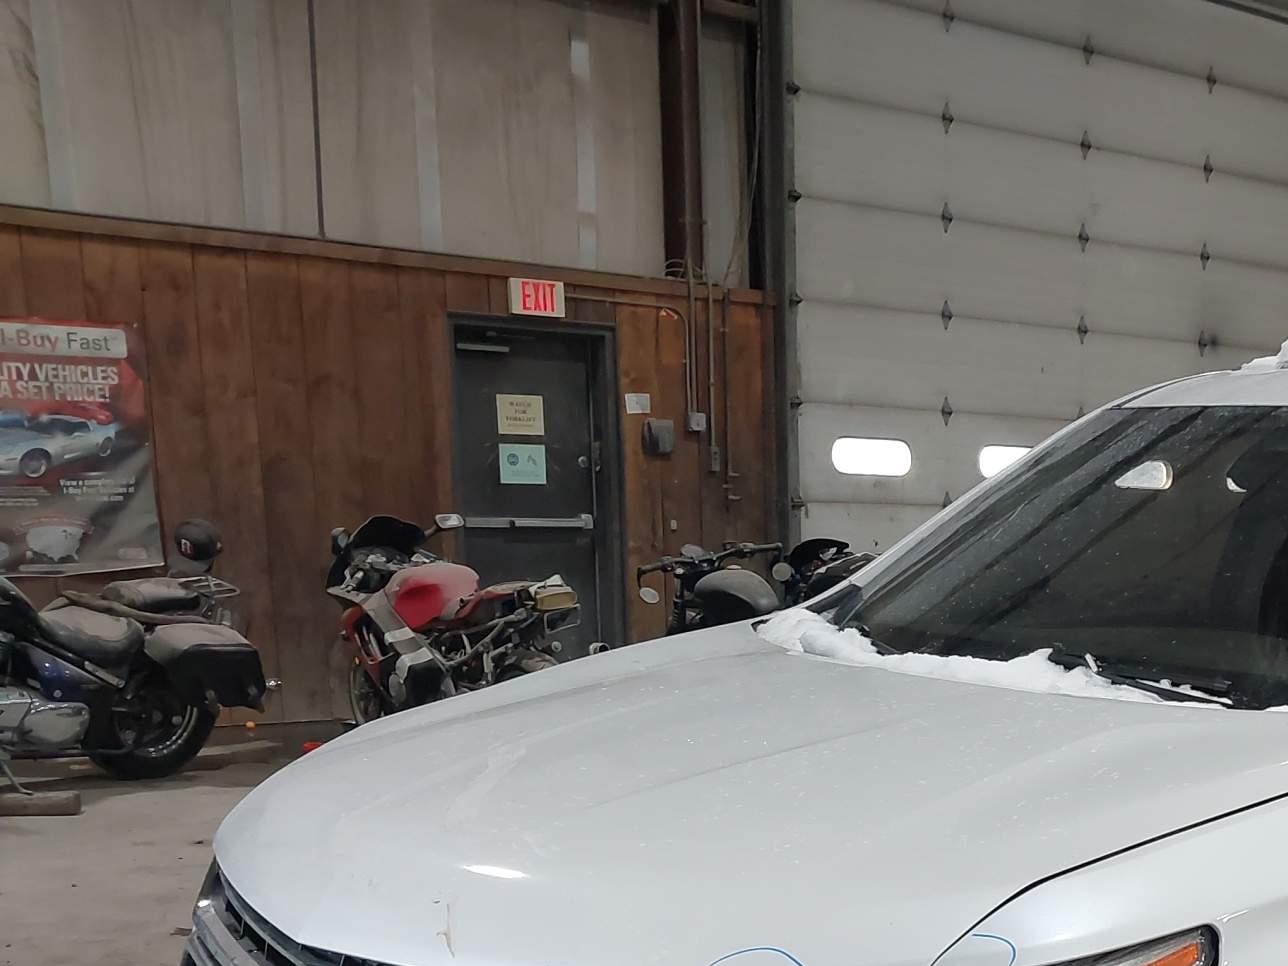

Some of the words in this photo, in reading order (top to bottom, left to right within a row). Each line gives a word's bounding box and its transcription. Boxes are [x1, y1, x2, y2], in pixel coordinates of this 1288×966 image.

[521, 281, 556, 313] EXIT
[66, 332, 111, 352] Fast
[34, 363, 119, 384] VEHICLES
[16, 381, 50, 400] SET
[53, 383, 110, 402] PRICE!
